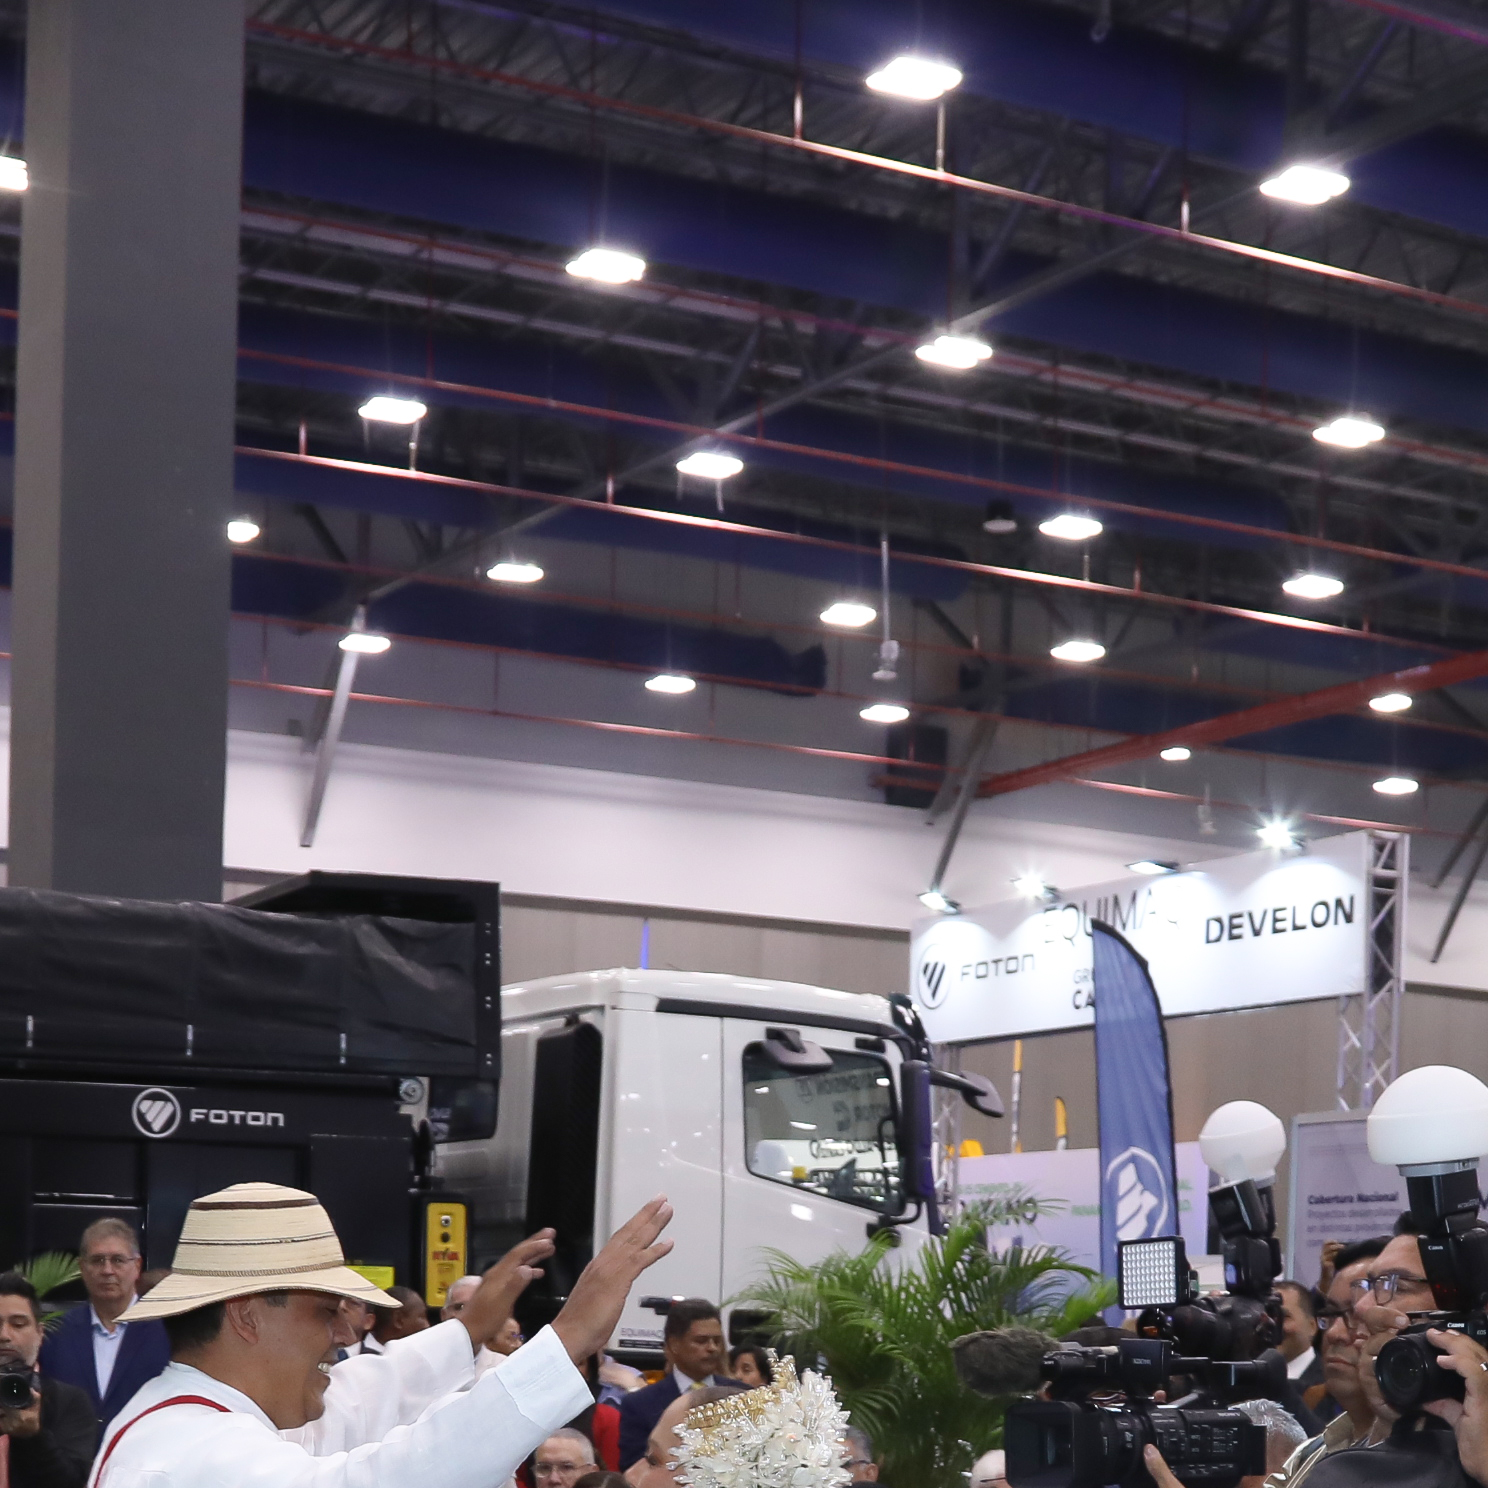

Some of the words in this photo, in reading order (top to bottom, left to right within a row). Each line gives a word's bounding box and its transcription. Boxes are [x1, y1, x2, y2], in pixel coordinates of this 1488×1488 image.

[1204, 894, 1355, 944] DEVELON
[960, 954, 1036, 982] FOTON
[189, 1107, 285, 1127] FOTON
